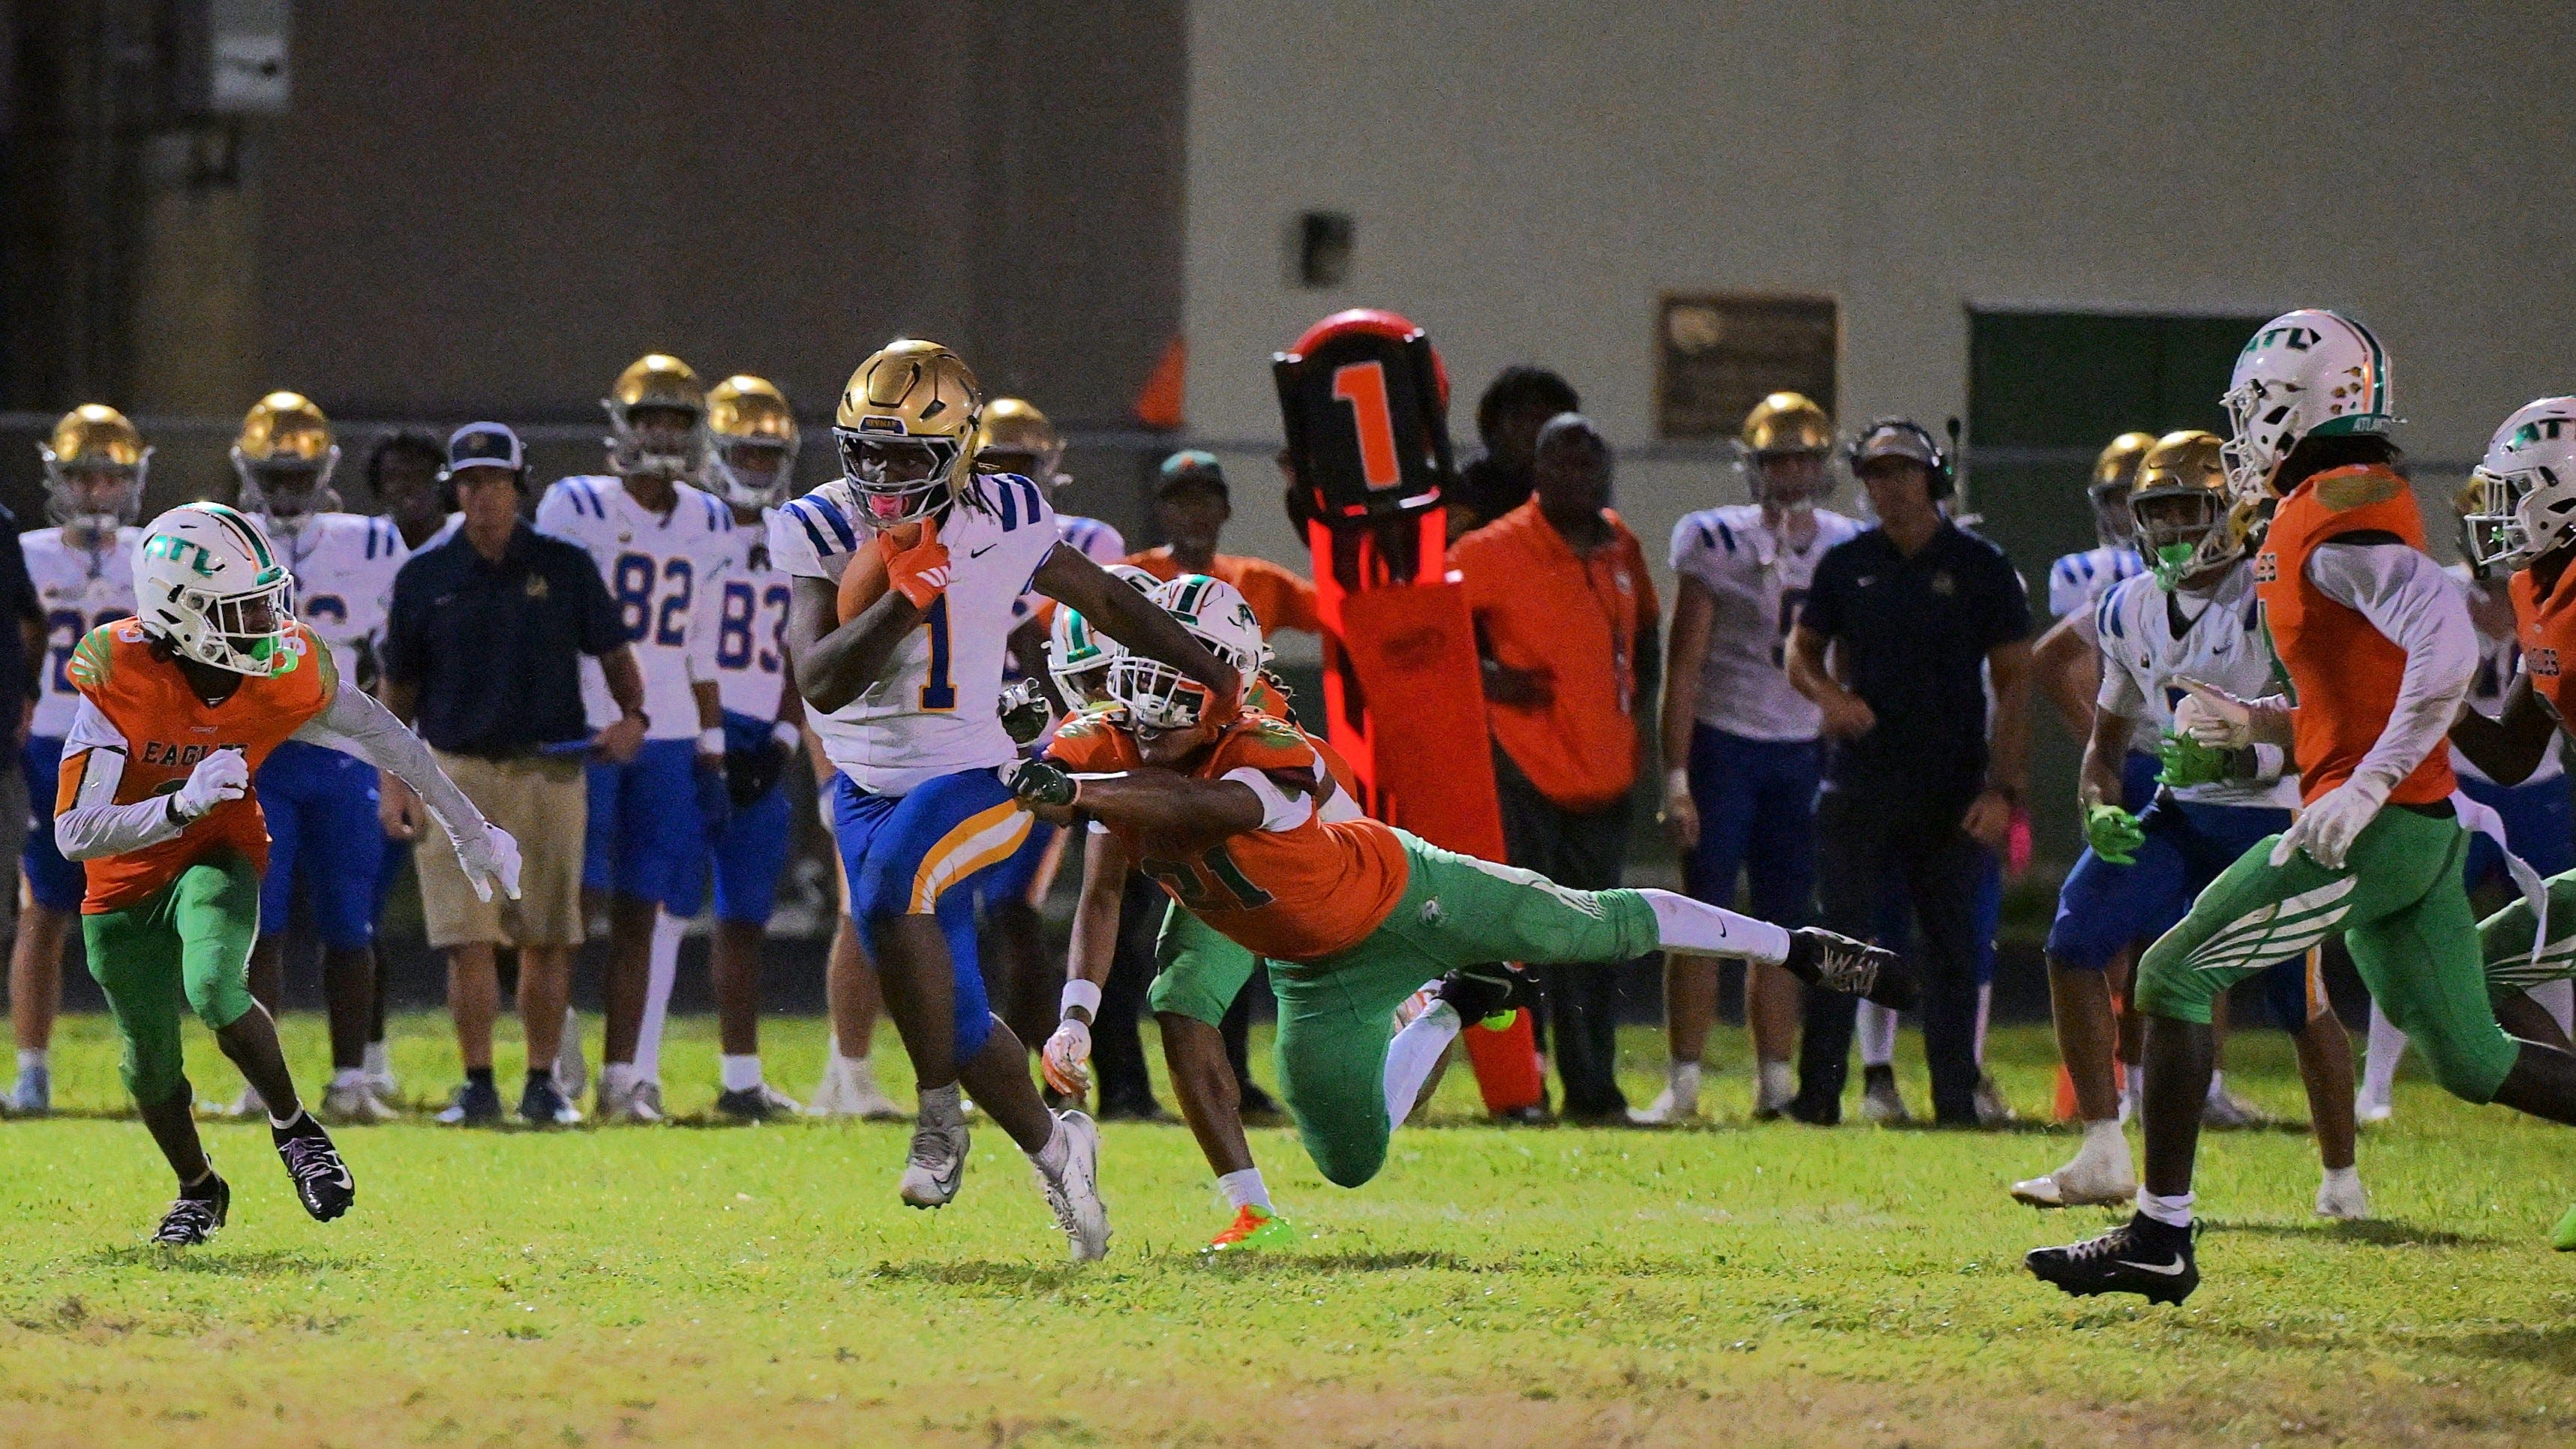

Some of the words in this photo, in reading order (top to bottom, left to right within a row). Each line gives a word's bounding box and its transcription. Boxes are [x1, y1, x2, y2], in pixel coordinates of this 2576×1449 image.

[1332, 360, 1402, 492] 1
[2514, 417, 2576, 452] AT
[145, 534, 214, 579] ATL
[616, 552, 693, 648] 82
[716, 580, 791, 673] 83
[919, 592, 958, 711] 1
[1140, 843, 1276, 912] 21
